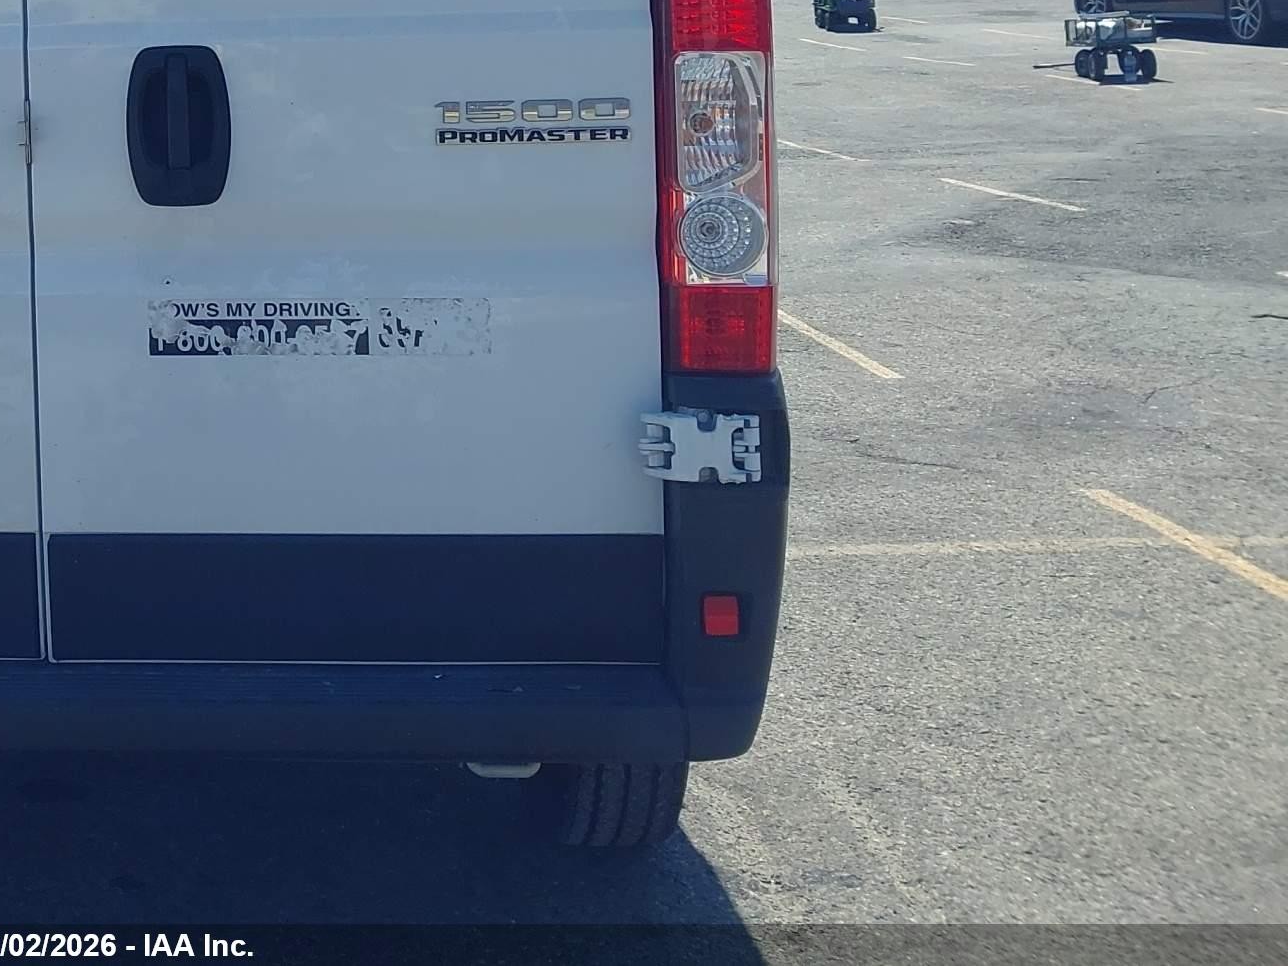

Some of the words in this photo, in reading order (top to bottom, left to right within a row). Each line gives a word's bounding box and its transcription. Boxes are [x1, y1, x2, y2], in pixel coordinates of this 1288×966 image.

[434, 97, 632, 124] 1500
[226, 302, 257, 317] MY
[263, 302, 361, 317] DRIVING
